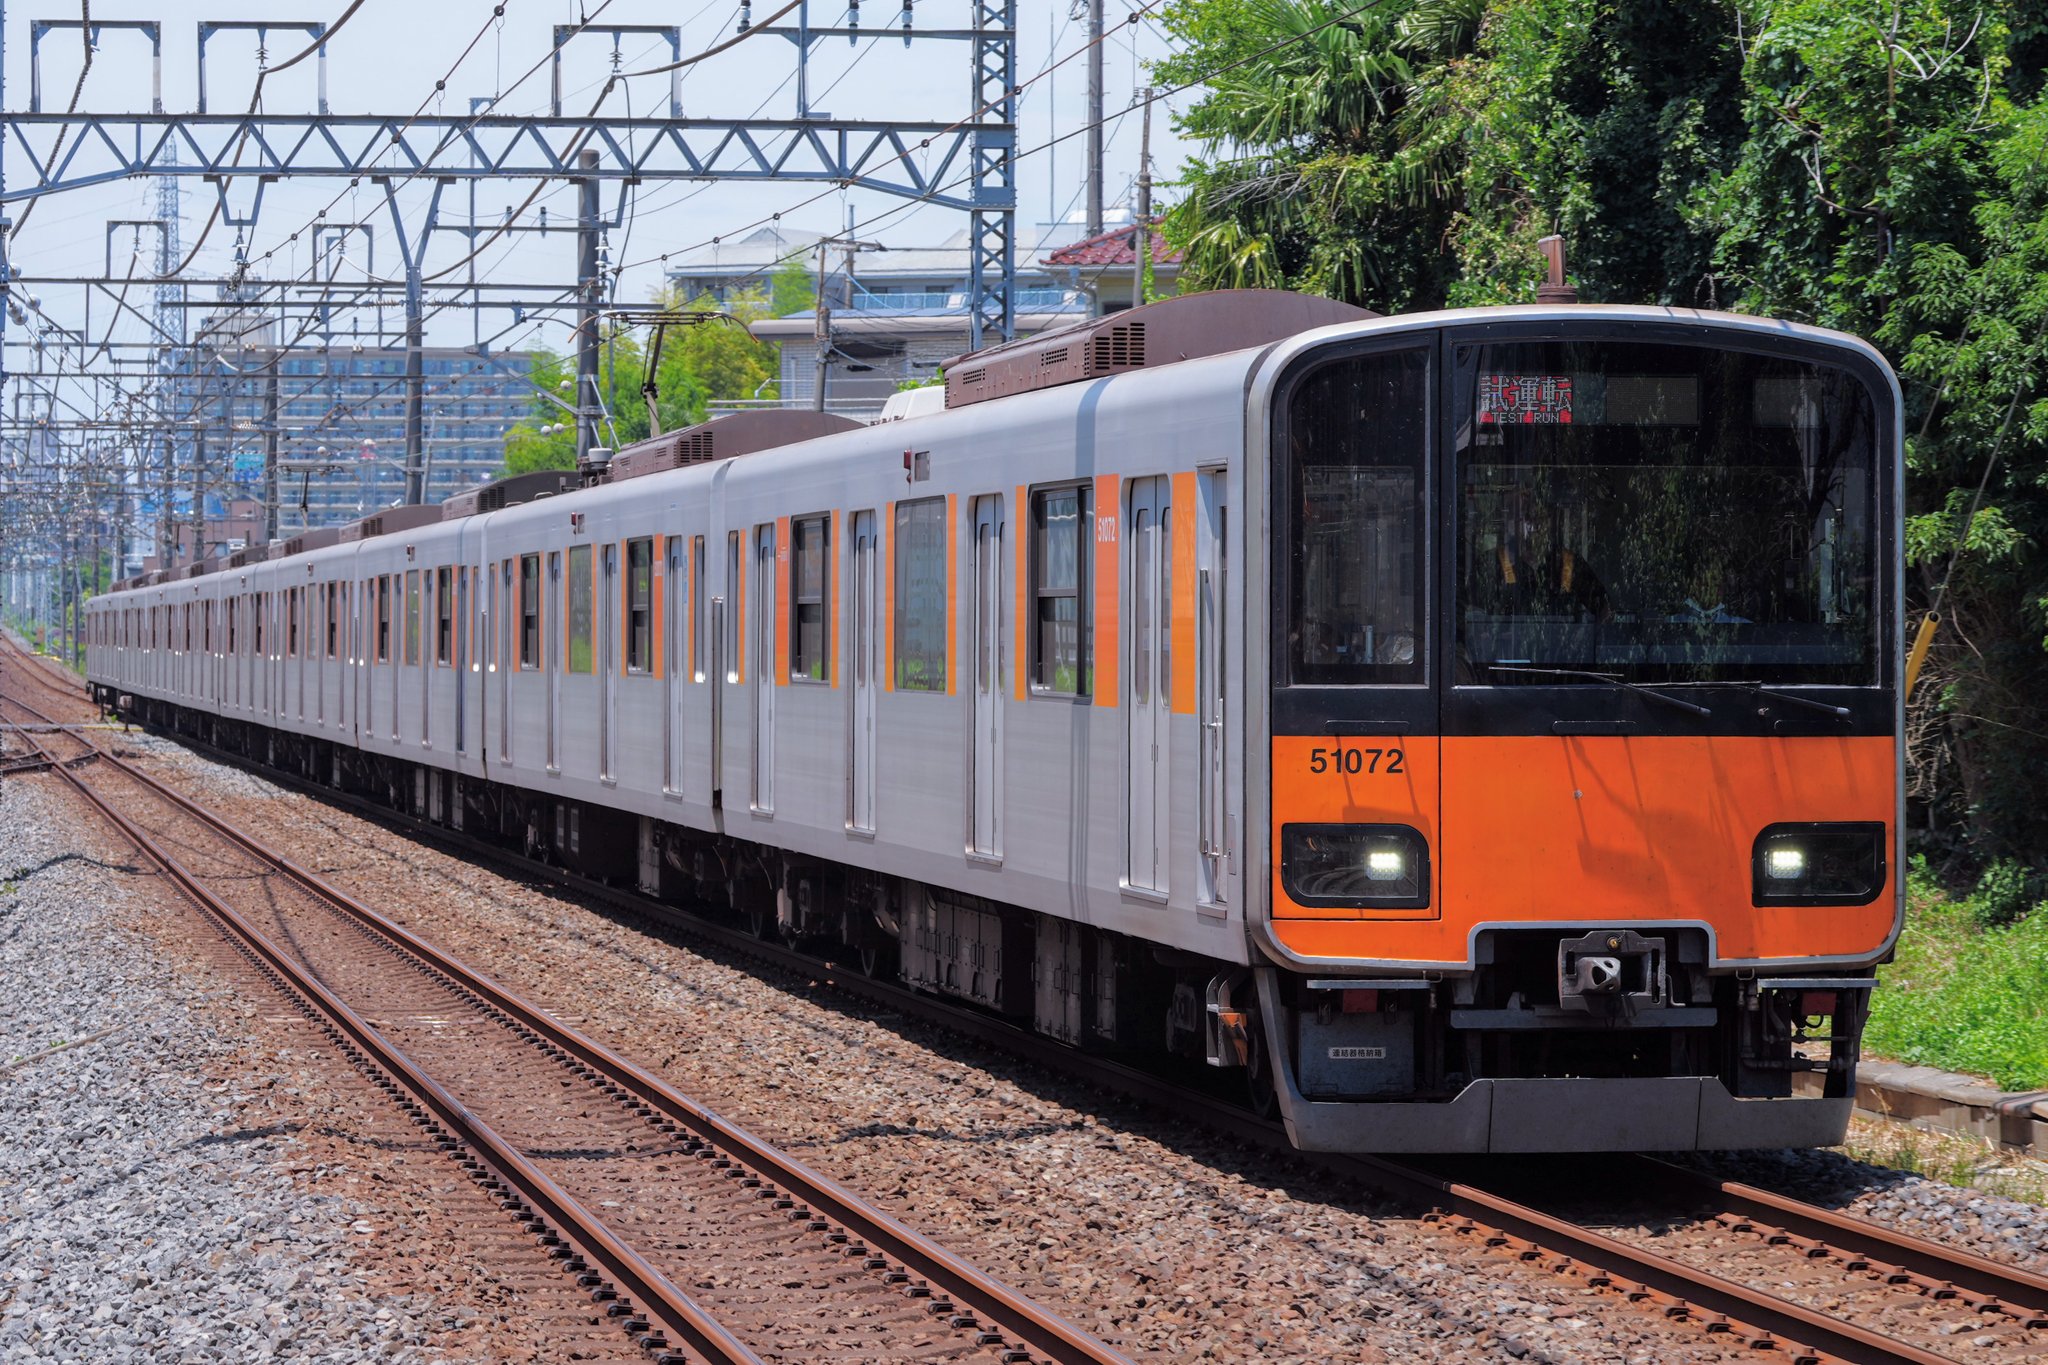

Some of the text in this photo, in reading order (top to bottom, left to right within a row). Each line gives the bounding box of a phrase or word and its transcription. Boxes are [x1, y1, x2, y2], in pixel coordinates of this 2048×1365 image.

[1480, 375, 1572, 412] 試運転
[1492, 412, 1559, 424] TEST RUN
[1098, 516, 1116, 543] 51072
[1310, 748, 1404, 774] 51072
